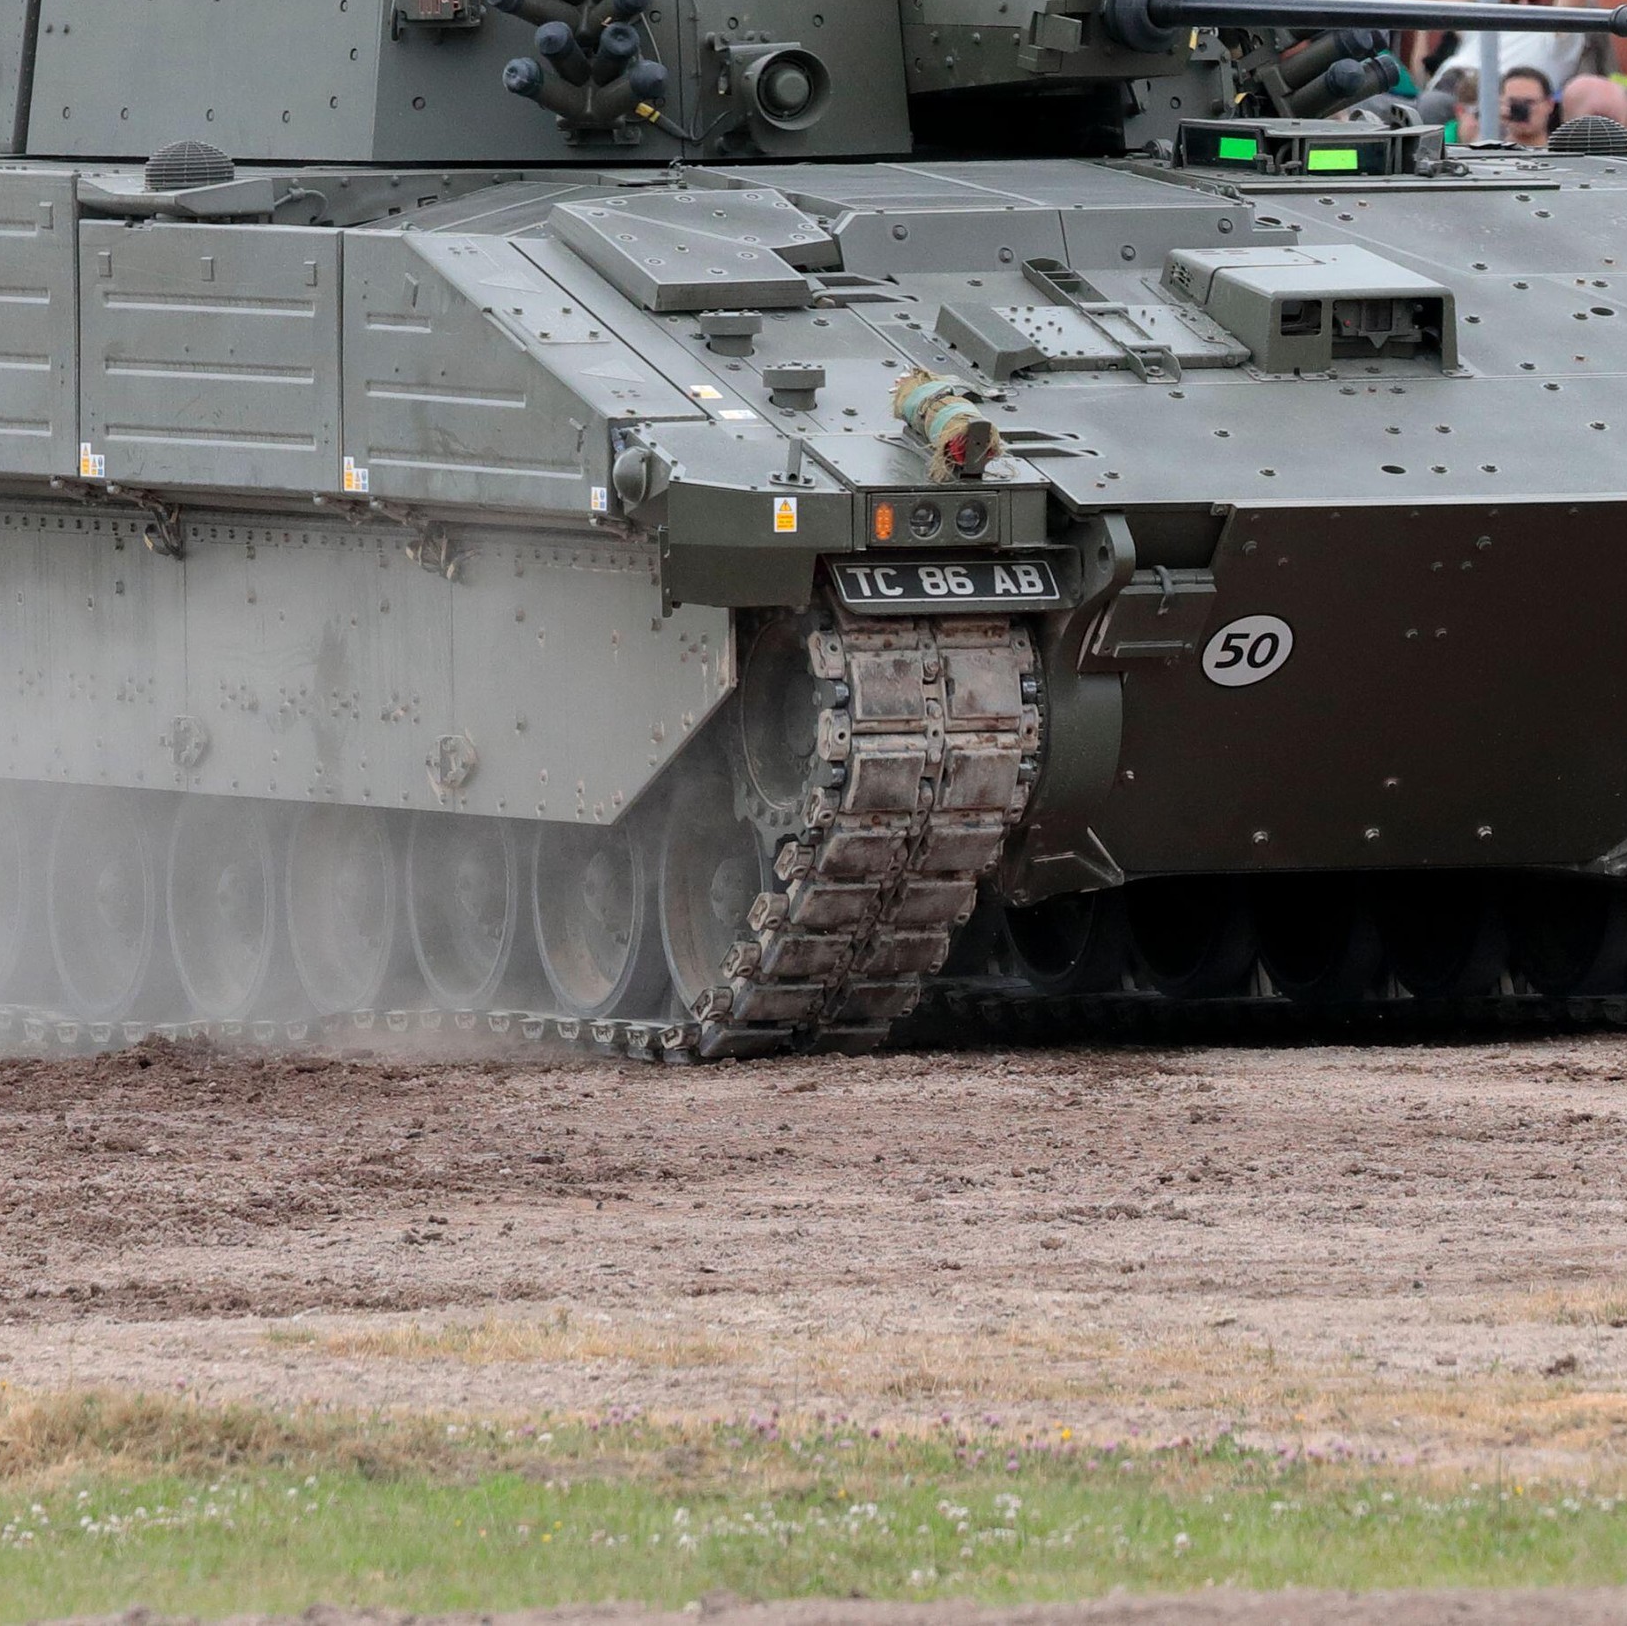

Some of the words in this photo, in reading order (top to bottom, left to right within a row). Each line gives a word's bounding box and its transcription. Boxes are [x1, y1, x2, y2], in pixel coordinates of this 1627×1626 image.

[845, 566, 905, 598] TC
[917, 565, 976, 597] 86
[992, 564, 1045, 595] AB
[1213, 632, 1280, 669] 50
